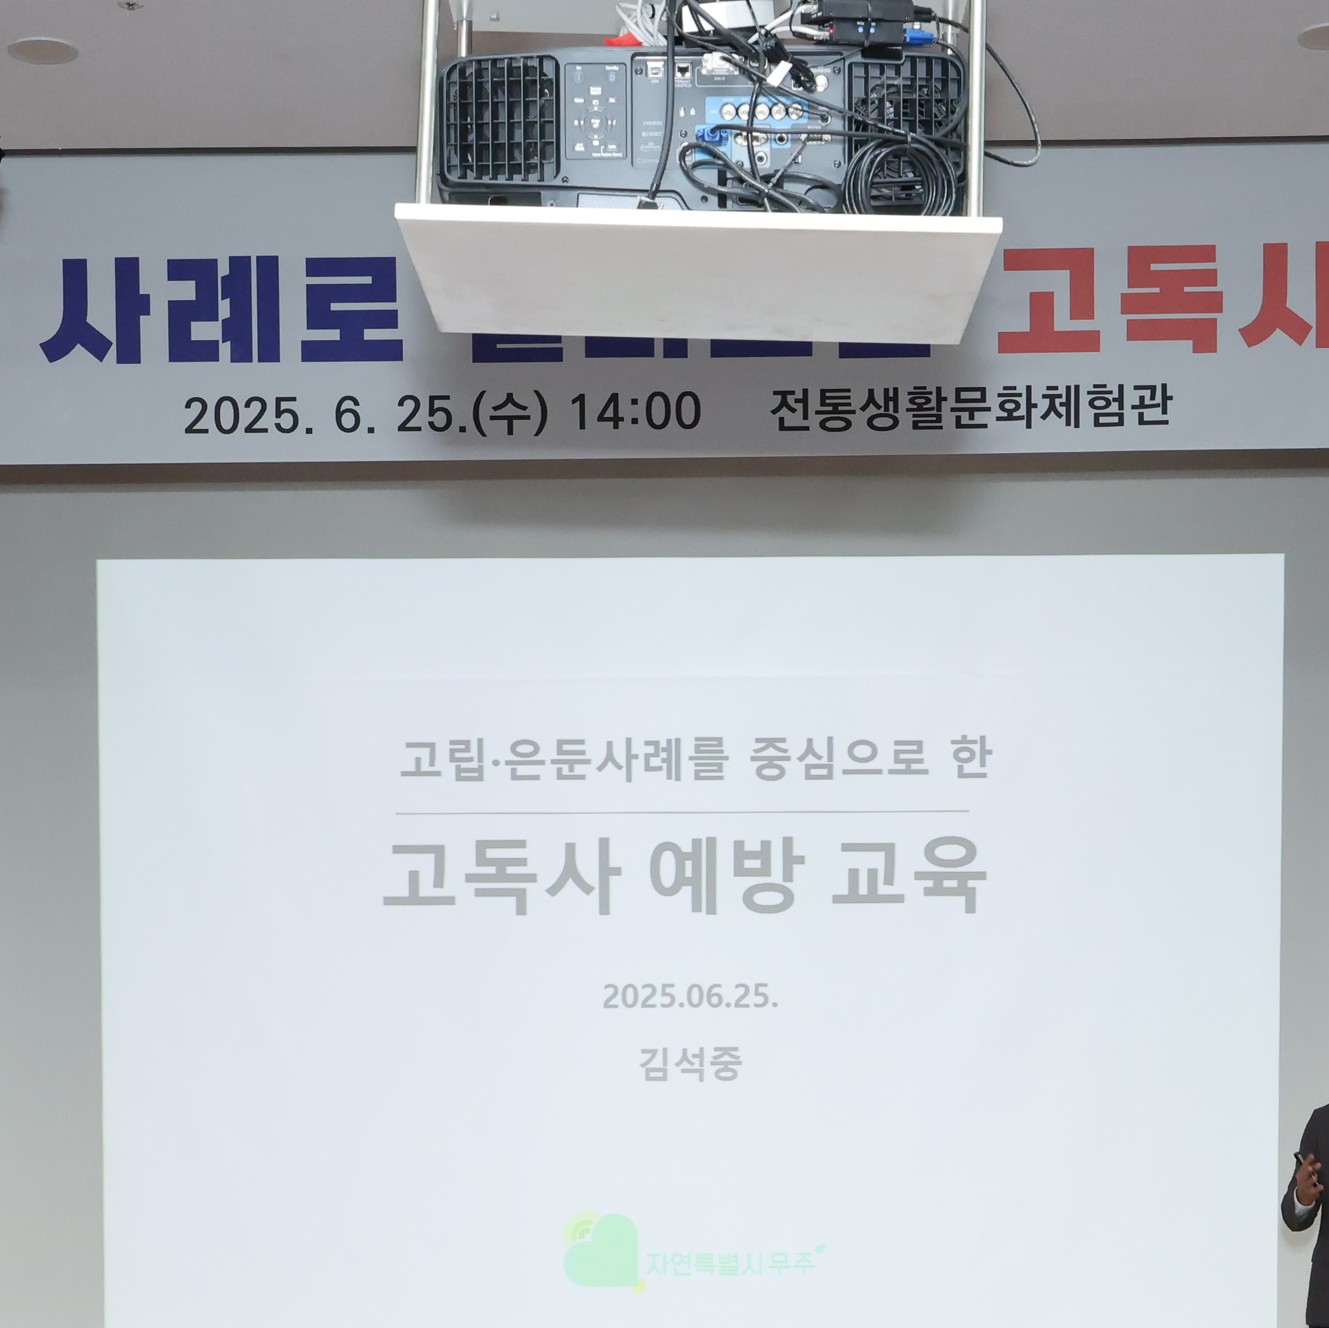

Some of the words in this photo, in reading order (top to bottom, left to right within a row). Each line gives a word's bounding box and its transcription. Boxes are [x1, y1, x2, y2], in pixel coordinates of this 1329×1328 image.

[39, 254, 404, 365] 사례로
[184, 396, 314, 435] 2025.
[334, 394, 376, 435] 6.
[396, 389, 549, 438] 25.(수)
[570, 389, 703, 432] 14:00
[769, 381, 1174, 433] 전통생활문화체험관
[399, 736, 731, 783] 고립·은둔사례를
[749, 735, 931, 782] 중심으로
[950, 734, 994, 780] 한
[381, 836, 623, 917] 고독사
[648, 835, 806, 916] 예방
[831, 834, 988, 916] 교육
[601, 982, 780, 1010] 2025.06.25.
[638, 1045, 744, 1083] 김석중
[645, 1251, 764, 1278] 자연특별시
[768, 1251, 816, 1277] 무주
